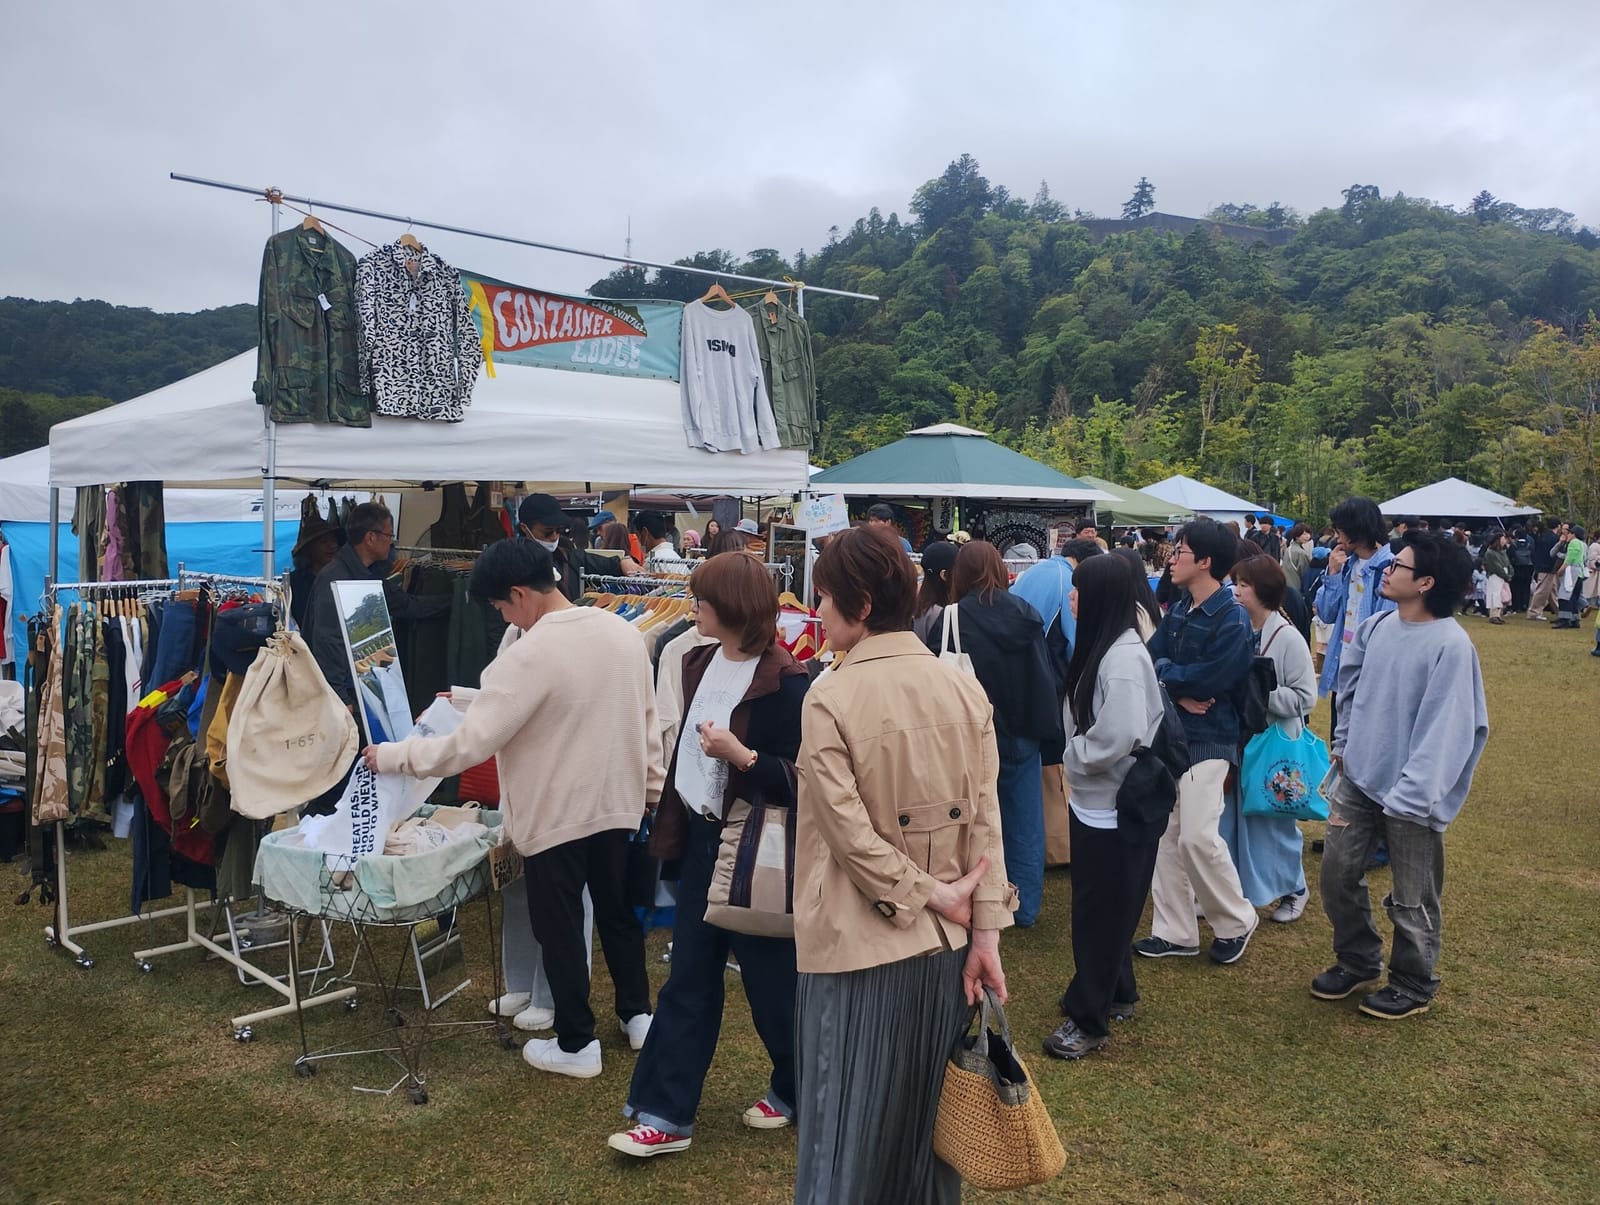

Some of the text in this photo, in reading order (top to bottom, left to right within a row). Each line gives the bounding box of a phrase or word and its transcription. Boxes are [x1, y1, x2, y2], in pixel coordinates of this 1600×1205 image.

[493, 290, 613, 348] CONTAINER
[350, 765, 364, 863] GREAT FASON
[360, 808, 371, 857] HOULD
[370, 815, 378, 829] TO
[366, 834, 375, 853] GO
